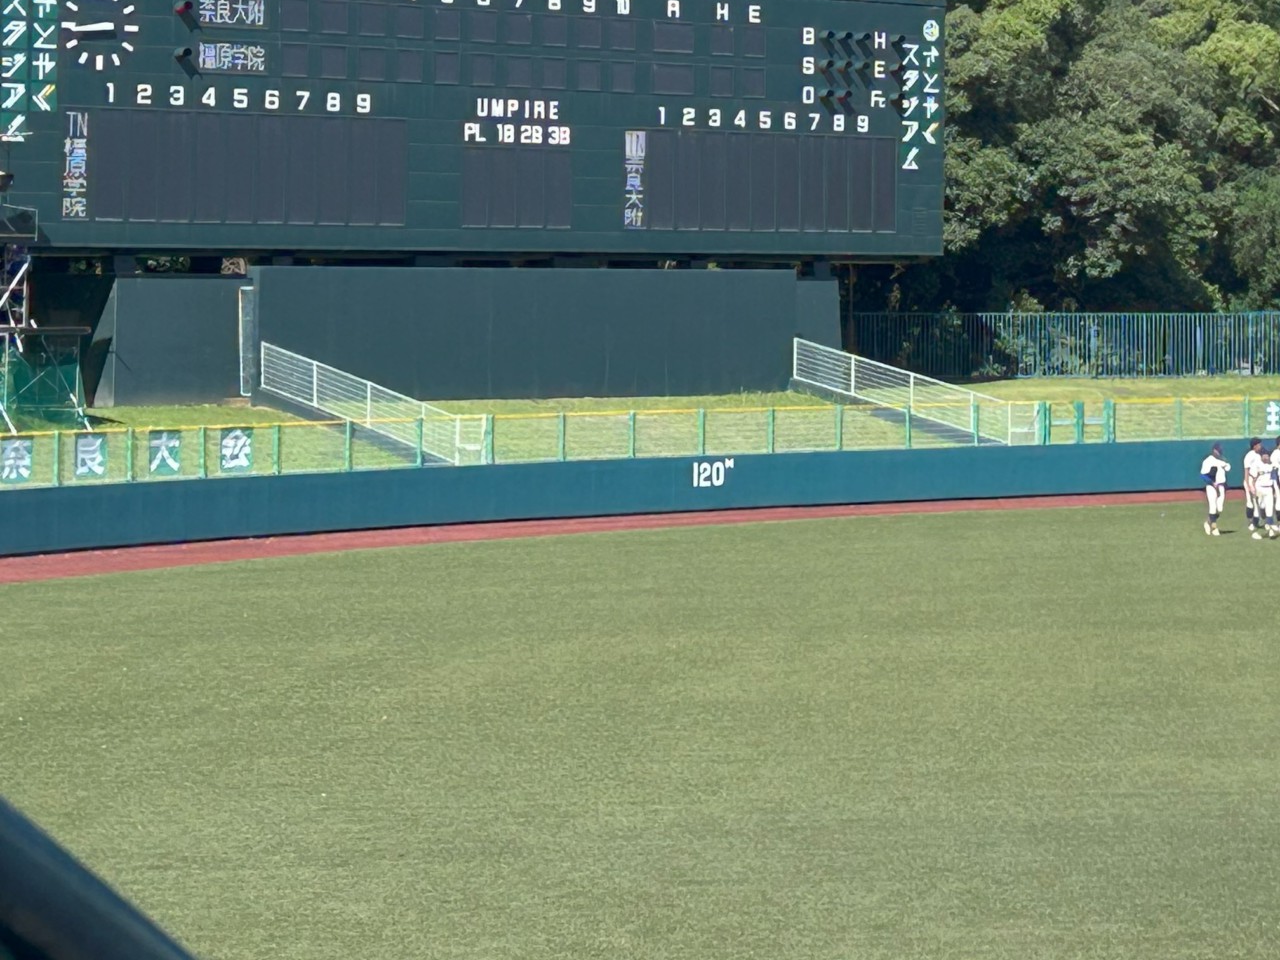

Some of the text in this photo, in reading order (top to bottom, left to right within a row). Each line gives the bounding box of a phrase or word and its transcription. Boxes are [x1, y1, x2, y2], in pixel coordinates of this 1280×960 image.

[667, 0, 680, 18] R
[716, 2, 729, 21] H
[748, 5, 761, 24] E
[802, 27, 886, 50] B H
[802, 56, 886, 79] S E
[106, 82, 371, 113] 1 2 3 4 5 6 7 8 9
[476, 97, 560, 120] UMPIRE
[658, 106, 869, 133] 1 2 3 4 5 6 7 8 9
[464, 122, 571, 145] PL 1B 2B 3B
